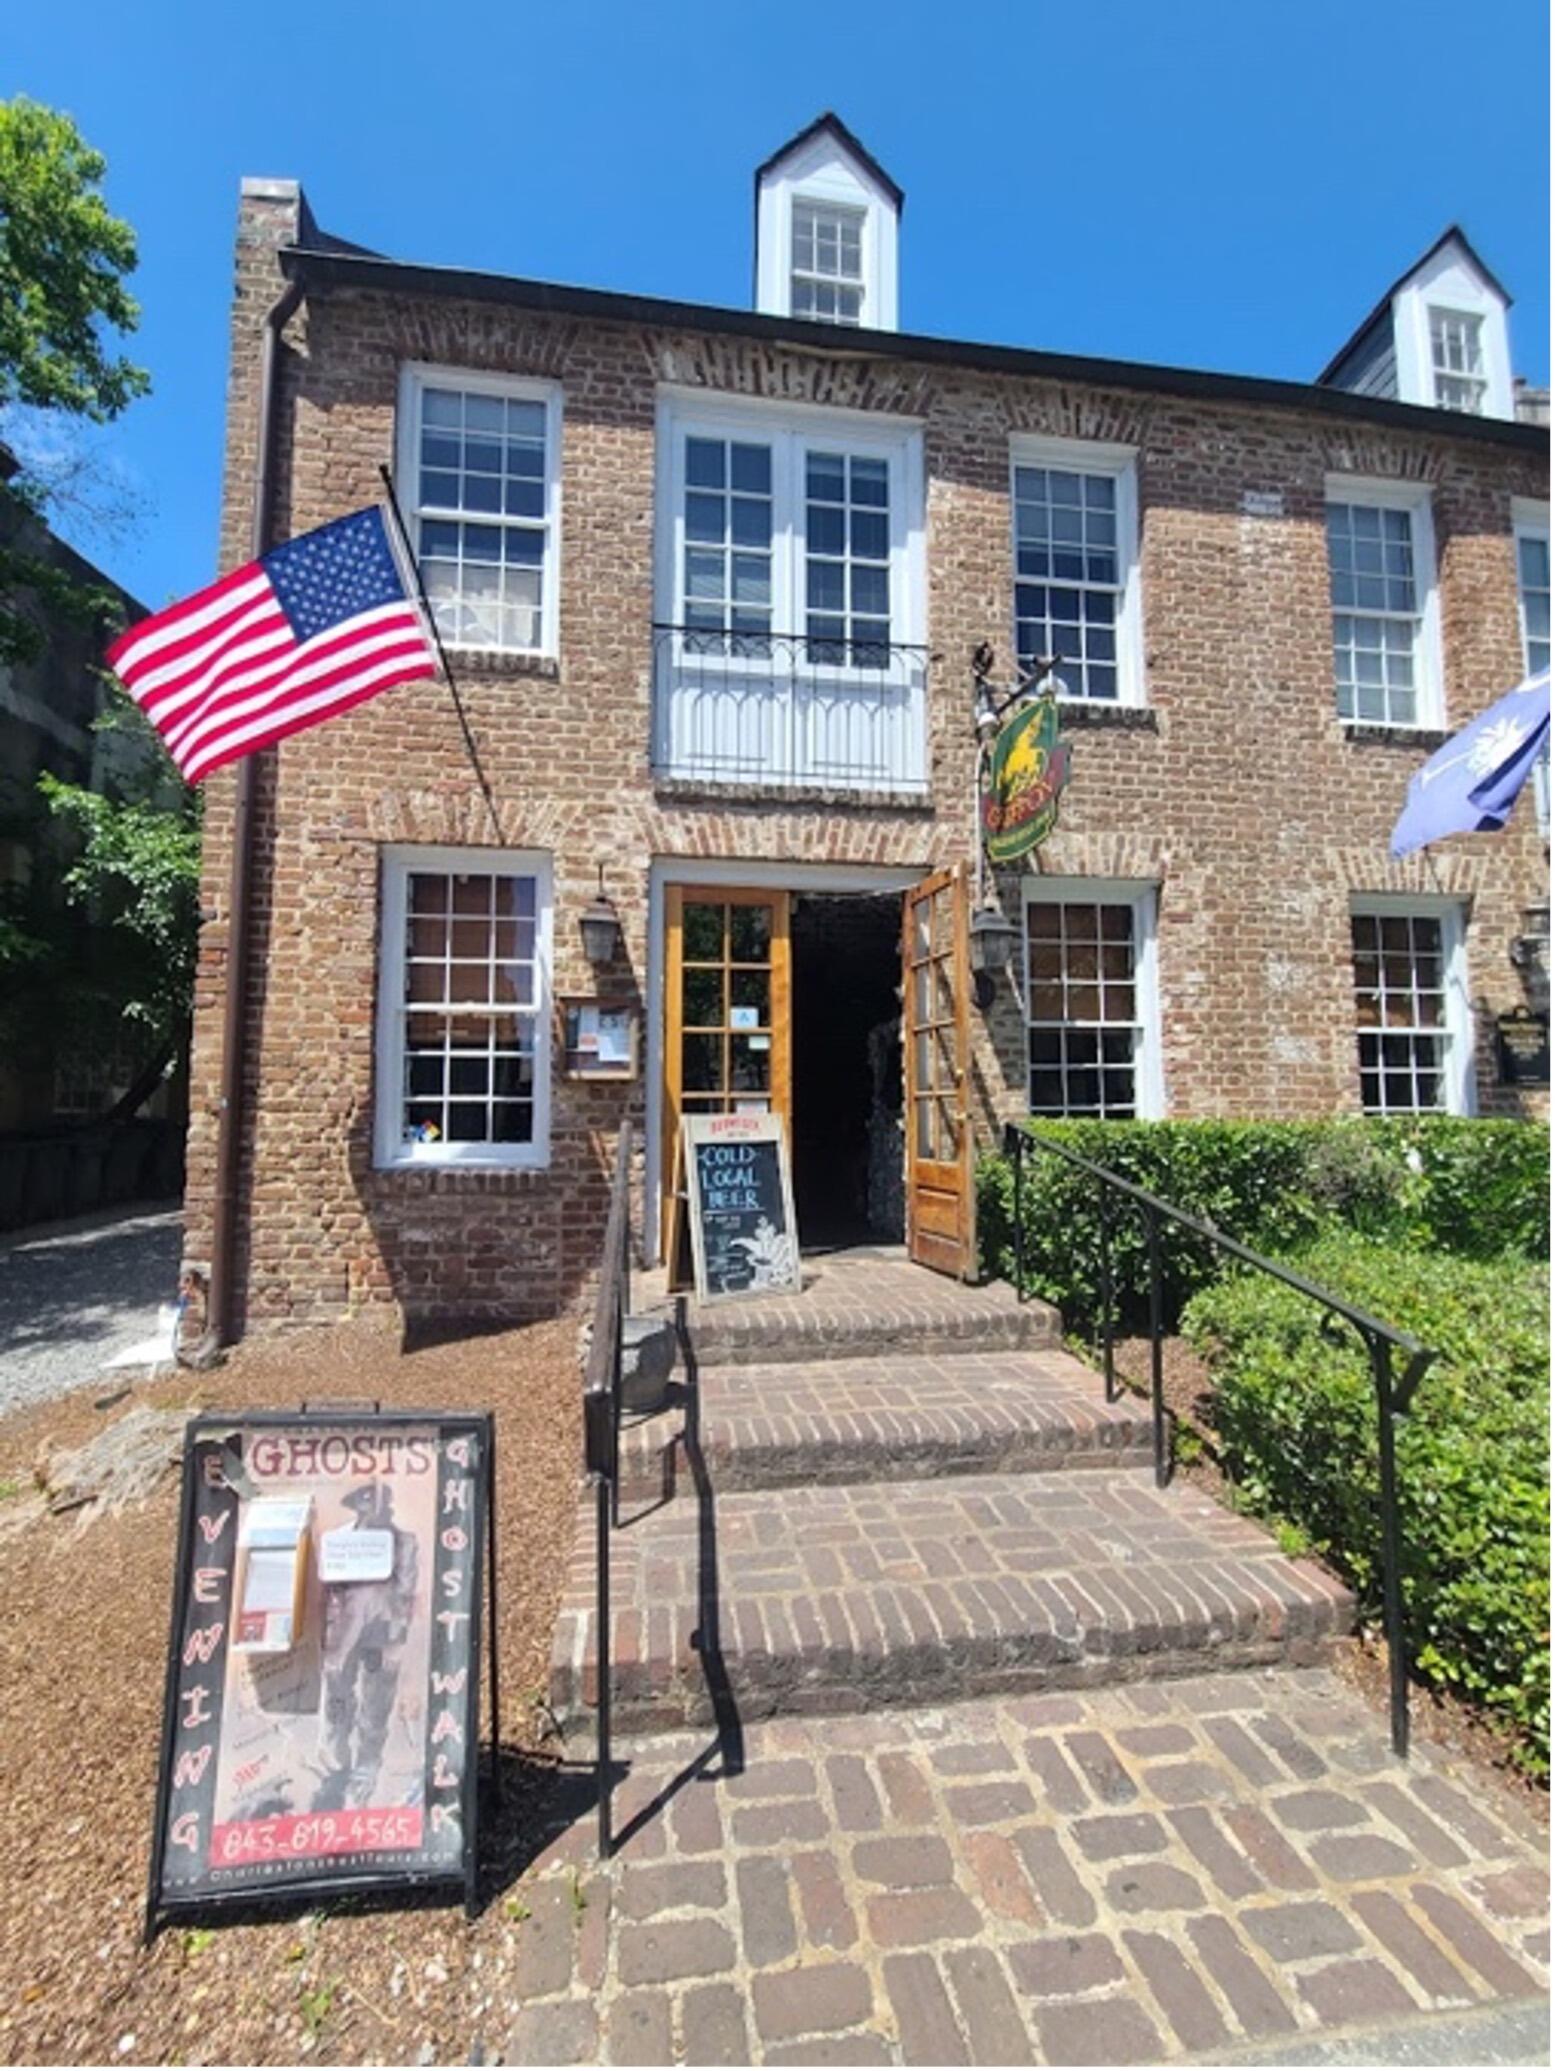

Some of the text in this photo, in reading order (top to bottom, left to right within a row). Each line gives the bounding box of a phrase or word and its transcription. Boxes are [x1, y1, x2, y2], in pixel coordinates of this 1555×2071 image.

[702, 1146, 757, 1167] COLD
[702, 1168, 761, 1190] LOCAL
[252, 1435, 432, 1477] GHOSTS
